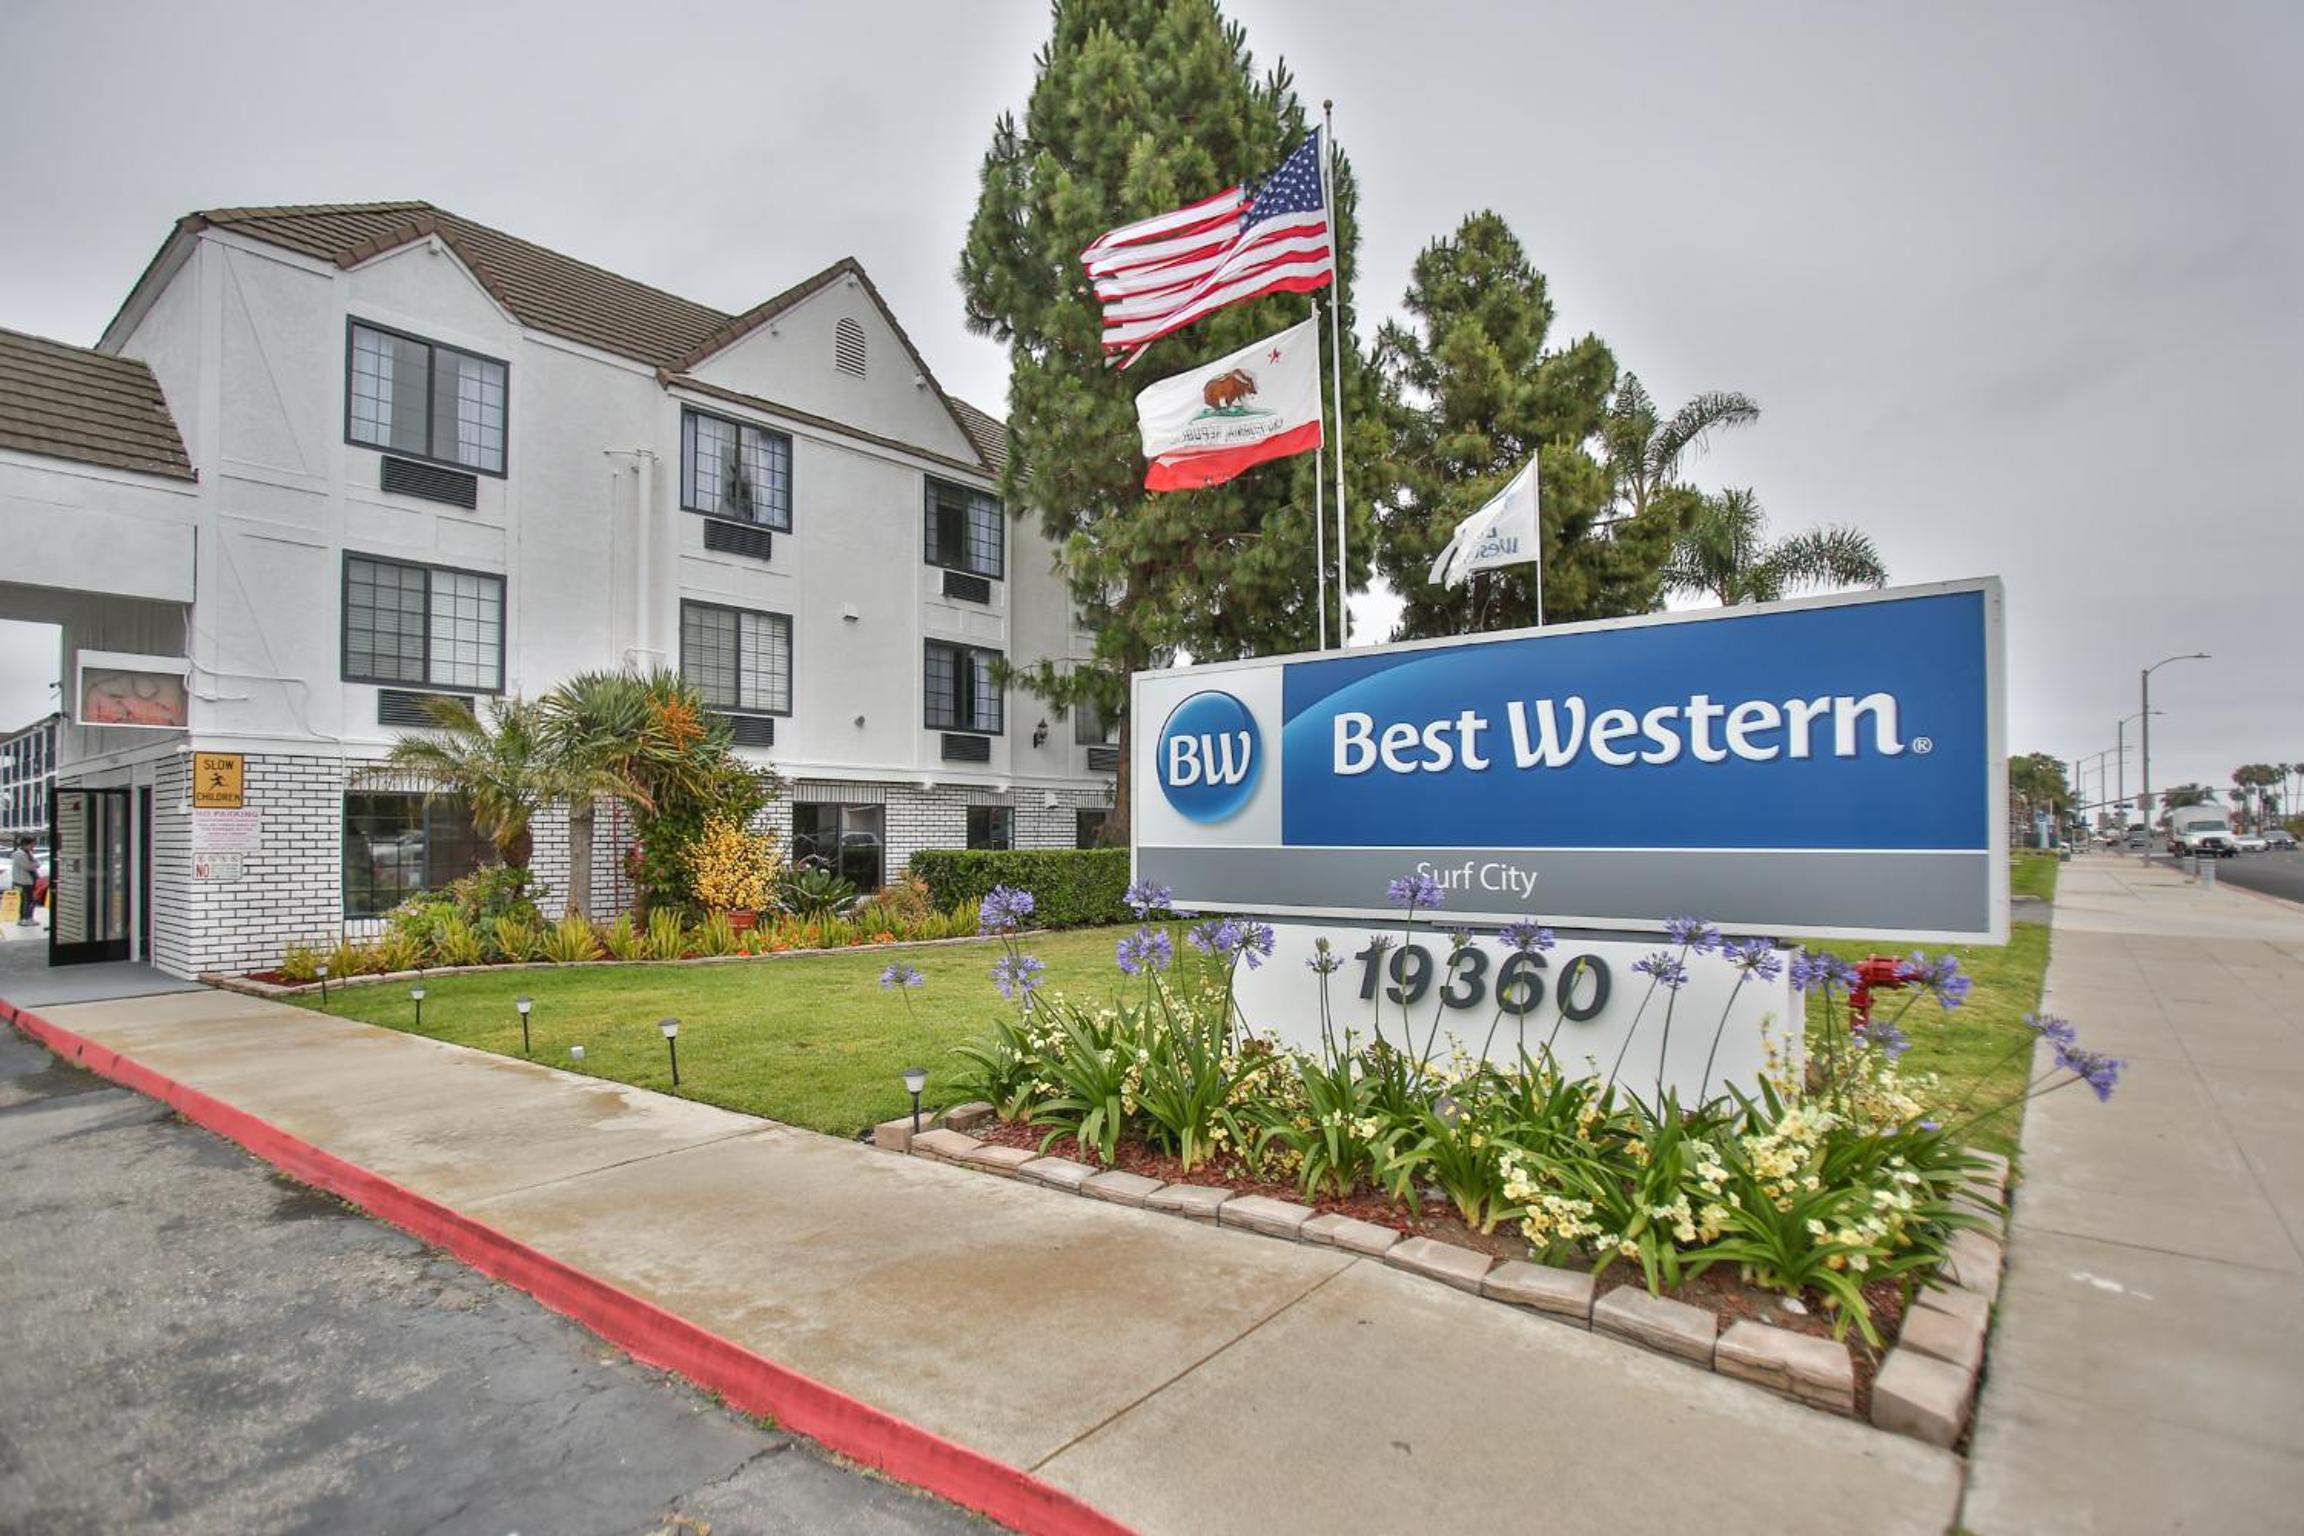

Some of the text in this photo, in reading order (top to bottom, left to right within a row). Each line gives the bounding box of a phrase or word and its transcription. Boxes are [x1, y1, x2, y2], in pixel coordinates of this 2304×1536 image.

[1333, 710, 1490, 775] Best
[1507, 692, 1905, 768] Western
[204, 759, 234, 770] SLOW
[1168, 730, 1252, 786] BW
[196, 791, 241, 802] CHILDREN
[1416, 861, 1537, 899] Surf City
[1355, 944, 1611, 1022] 19360
